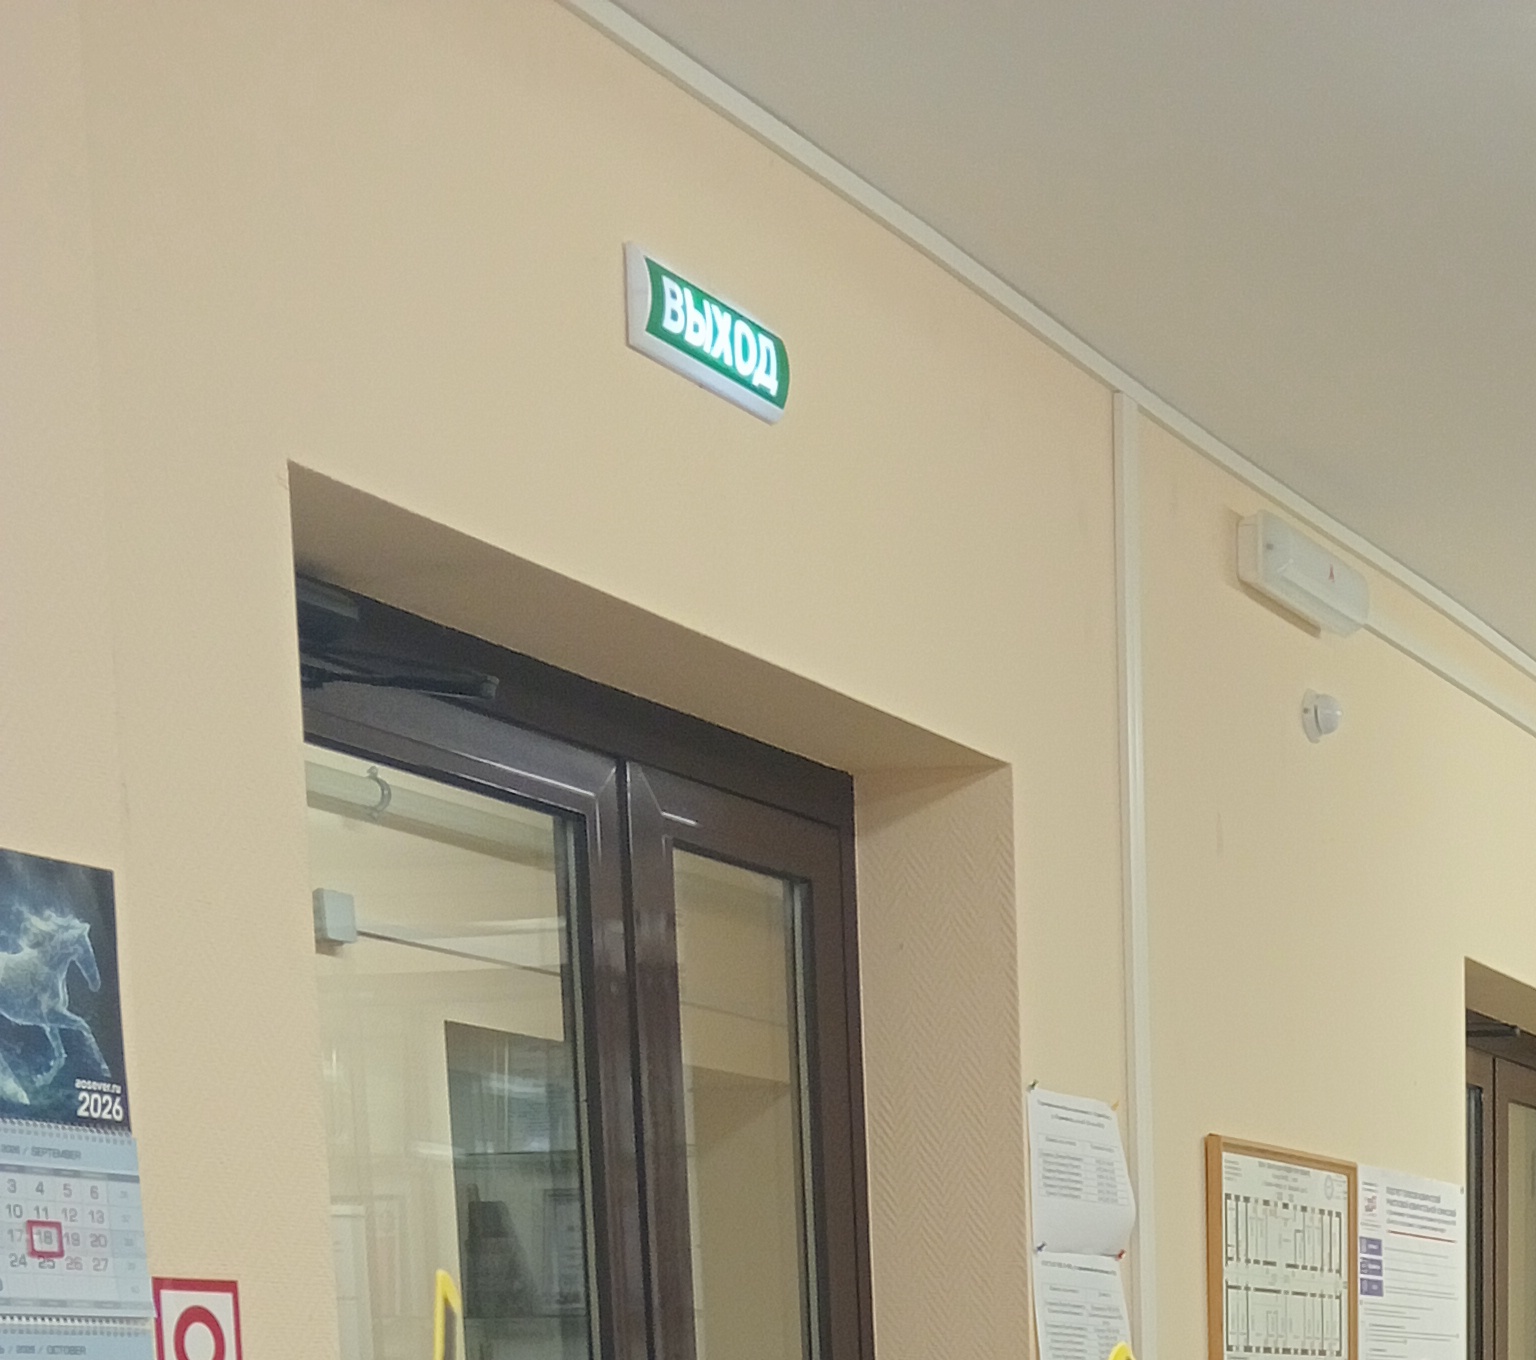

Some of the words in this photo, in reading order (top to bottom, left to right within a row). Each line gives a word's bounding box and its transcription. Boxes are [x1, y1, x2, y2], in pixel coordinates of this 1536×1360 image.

[661, 275, 778, 397] ВЫХОД
[75, 1079, 122, 1094] aosever.ru
[76, 1092, 124, 1122] 2026
[7, 1179, 17, 1194] 3
[35, 1181, 45, 1195] 4
[63, 1184, 73, 1198] 5
[90, 1185, 99, 1200] 6
[6, 1204, 23, 1219] 10
[34, 1206, 50, 1220] 11
[62, 1208, 78, 1222] 12
[88, 1210, 105, 1224] 13
[8, 1228, 24, 1243] 17
[36, 1230, 53, 1245] 18
[63, 1232, 81, 1247] 19
[89, 1234, 108, 1248] 20
[8, 1254, 28, 1268] 24
[65, 1256, 83, 1271] 26
[92, 1257, 109, 1272] 27
